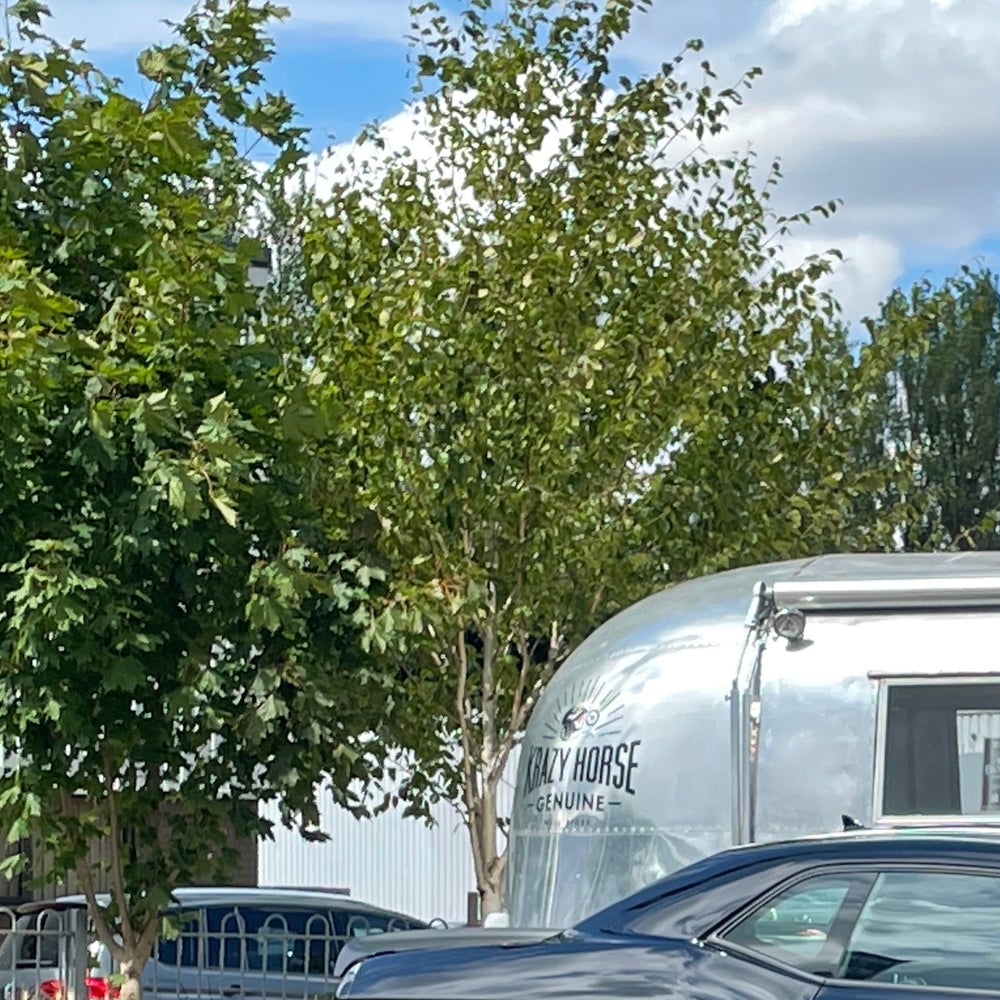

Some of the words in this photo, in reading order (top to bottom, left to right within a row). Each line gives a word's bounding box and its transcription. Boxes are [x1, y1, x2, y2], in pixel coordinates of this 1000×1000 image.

[523, 745, 571, 798] KRAZY
[573, 739, 641, 795] HORSE
[536, 791, 605, 812] GENUINE
